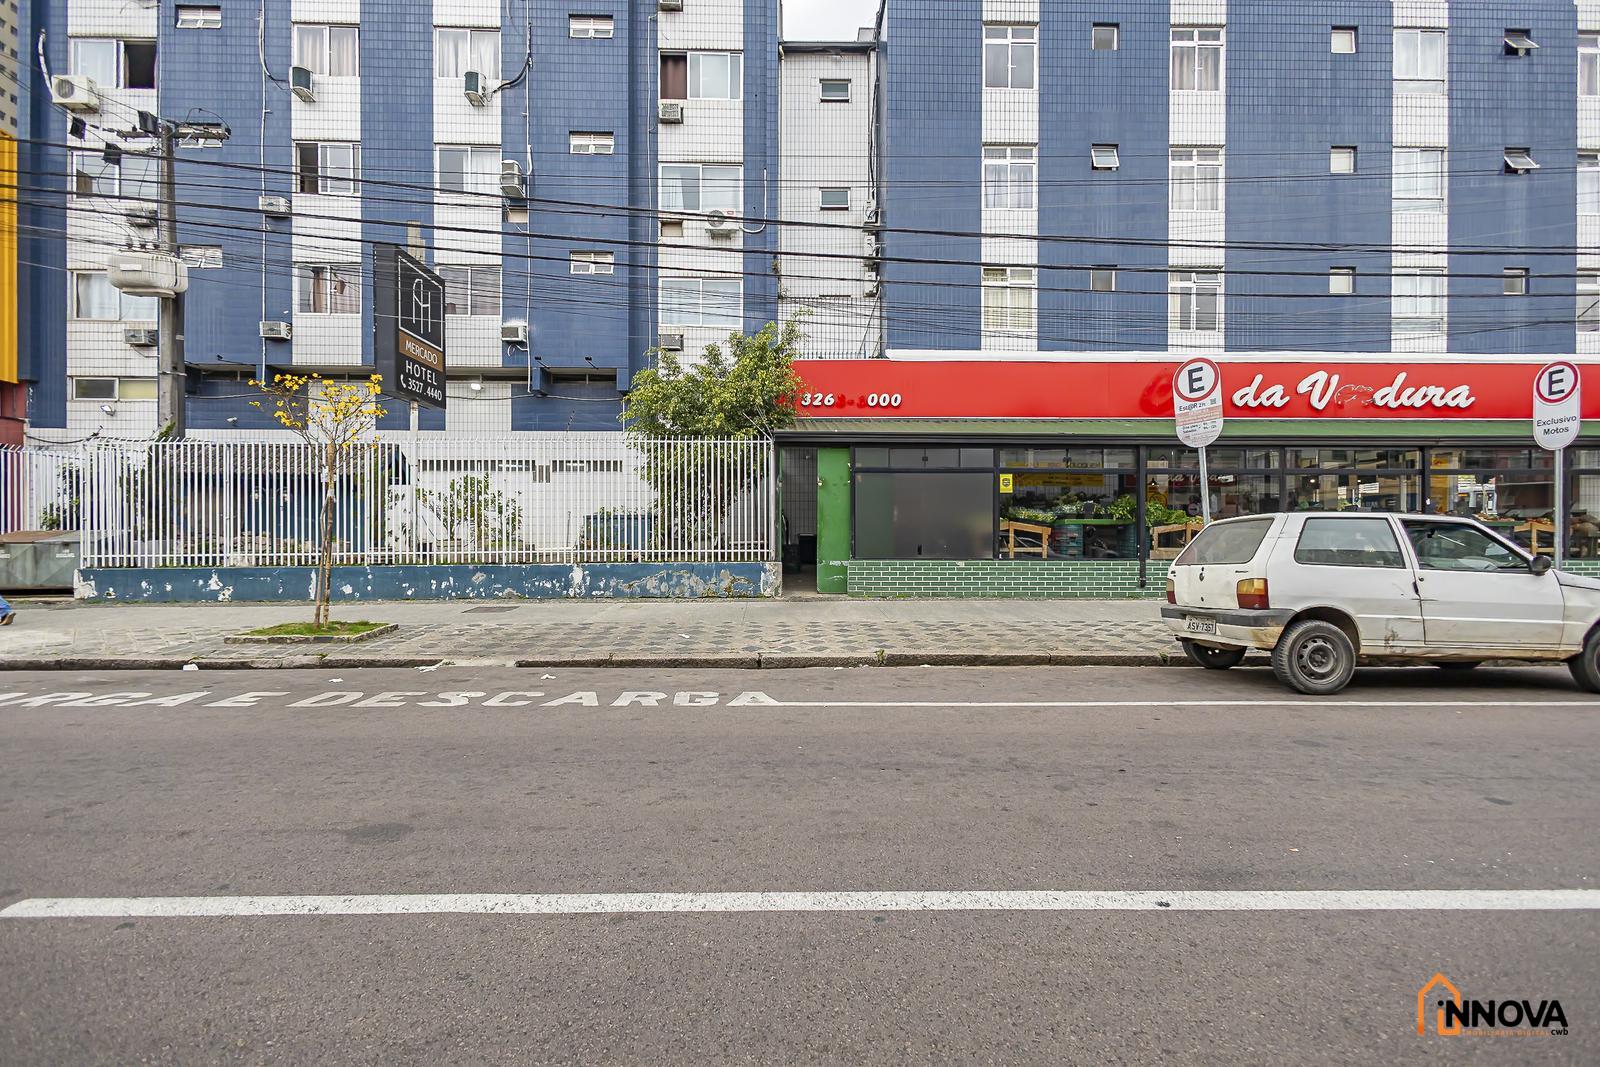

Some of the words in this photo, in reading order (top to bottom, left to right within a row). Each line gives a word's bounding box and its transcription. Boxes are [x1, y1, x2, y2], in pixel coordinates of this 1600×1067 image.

[405, 340, 438, 366] MERCADO
[405, 360, 438, 386] HOTEL
[1188, 366, 1205, 394] E
[1548, 368, 1565, 396] E
[1231, 374, 1290, 408] da
[1296, 370, 1476, 410] Vdura
[1537, 415, 1576, 427] Exclusivo
[1543, 426, 1569, 436] Motos
[286, 691, 782, 707] DESCARGA
